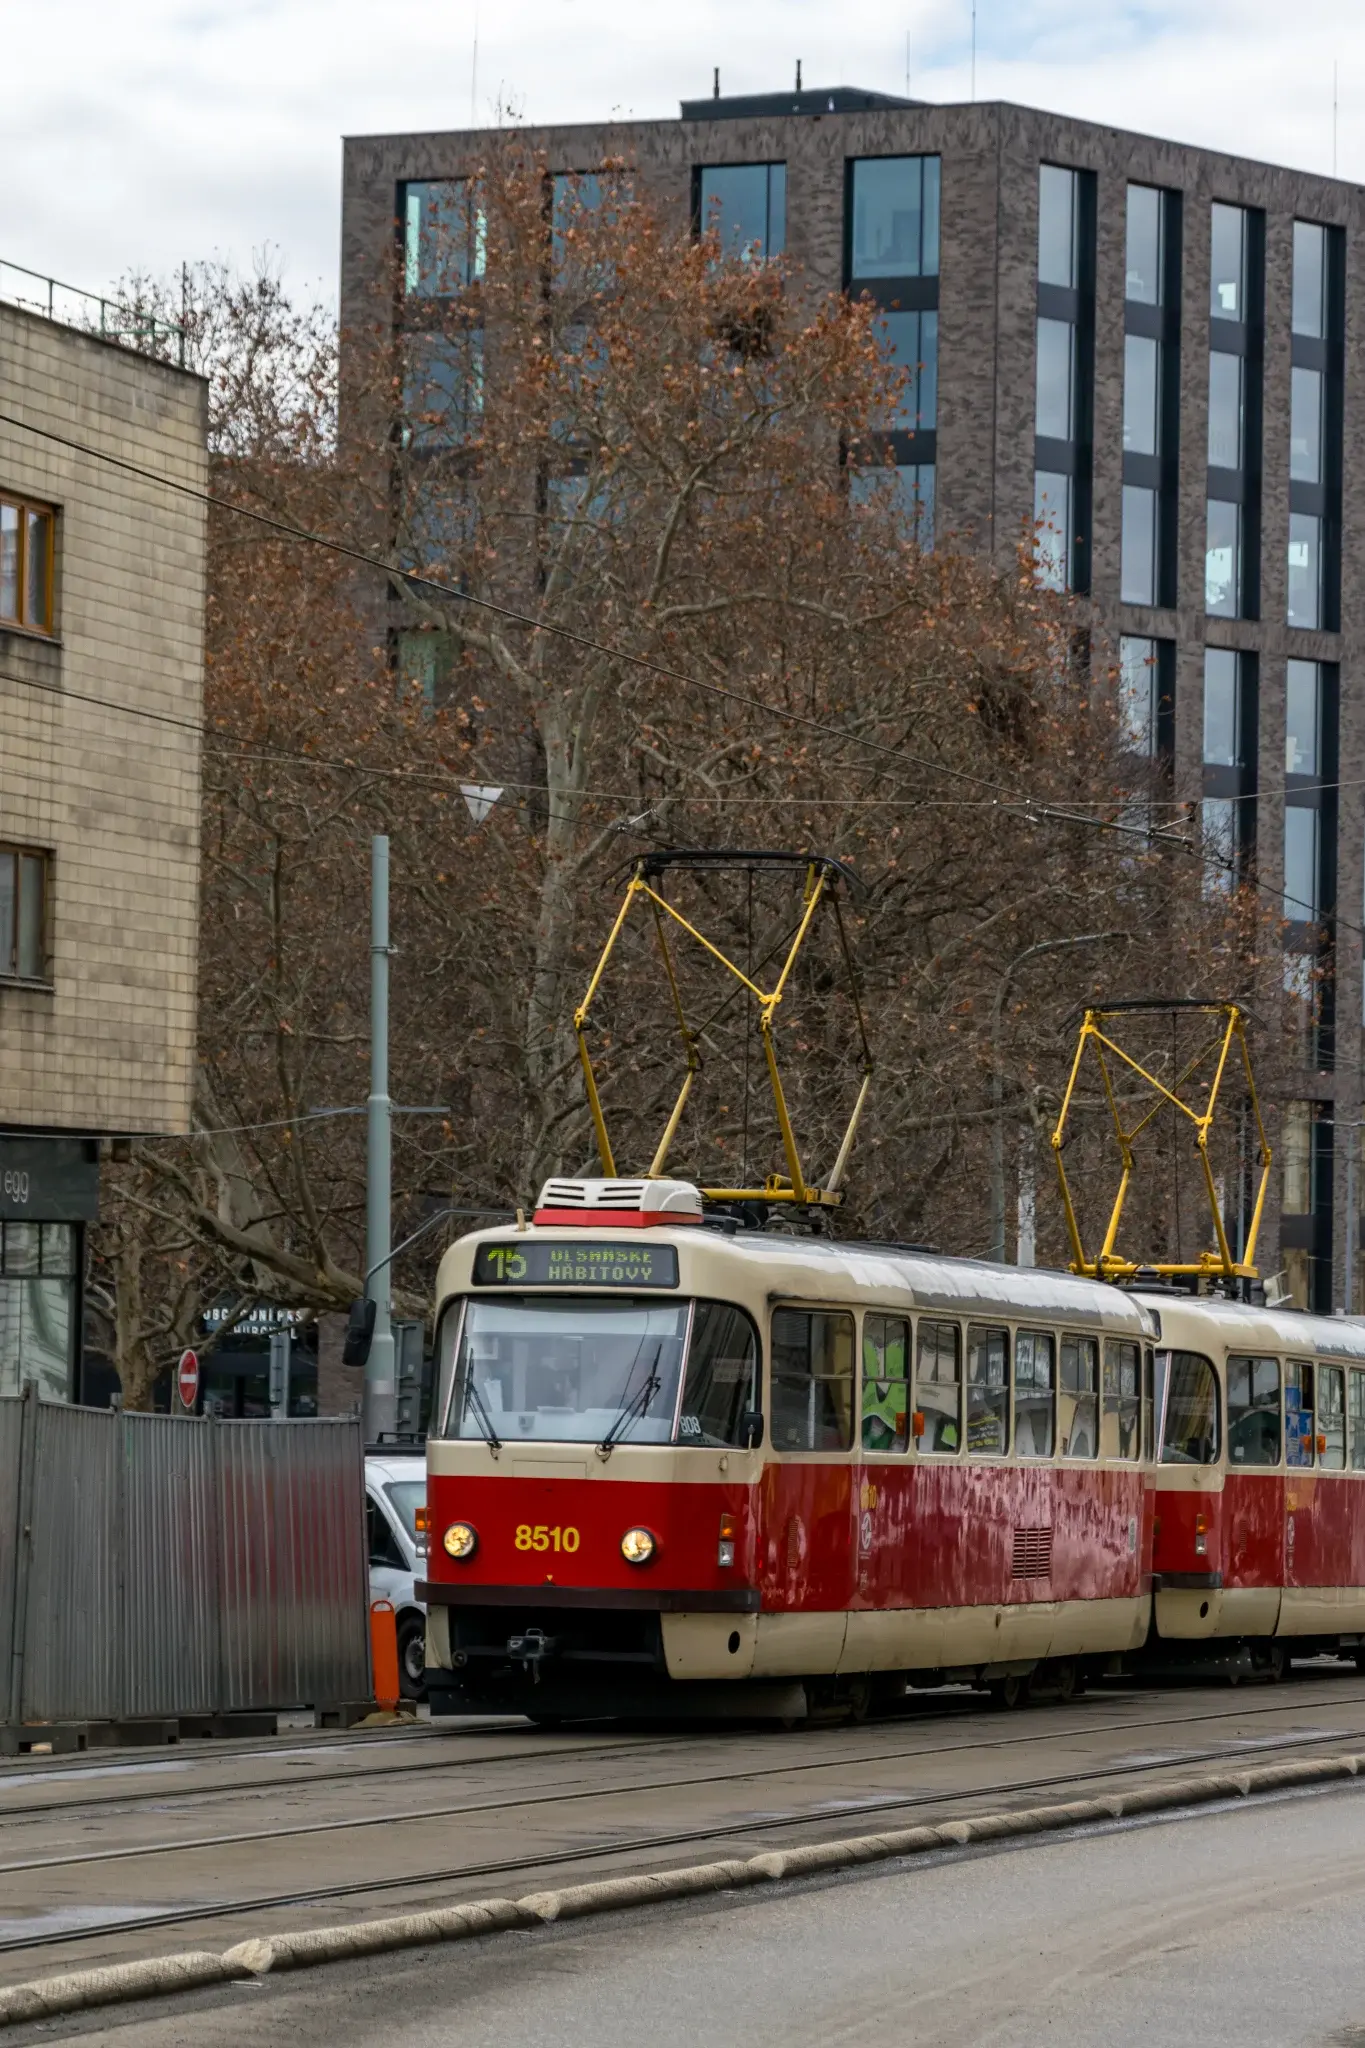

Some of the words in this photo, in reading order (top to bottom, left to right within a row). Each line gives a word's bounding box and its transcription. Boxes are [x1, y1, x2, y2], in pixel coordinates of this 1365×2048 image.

[4, 1170, 29, 1203] egg
[487, 1249, 527, 1279] 15
[549, 1262, 652, 1280] HŘBITOVY
[680, 1415, 702, 1434] 808
[514, 1524, 580, 1553] 8510
